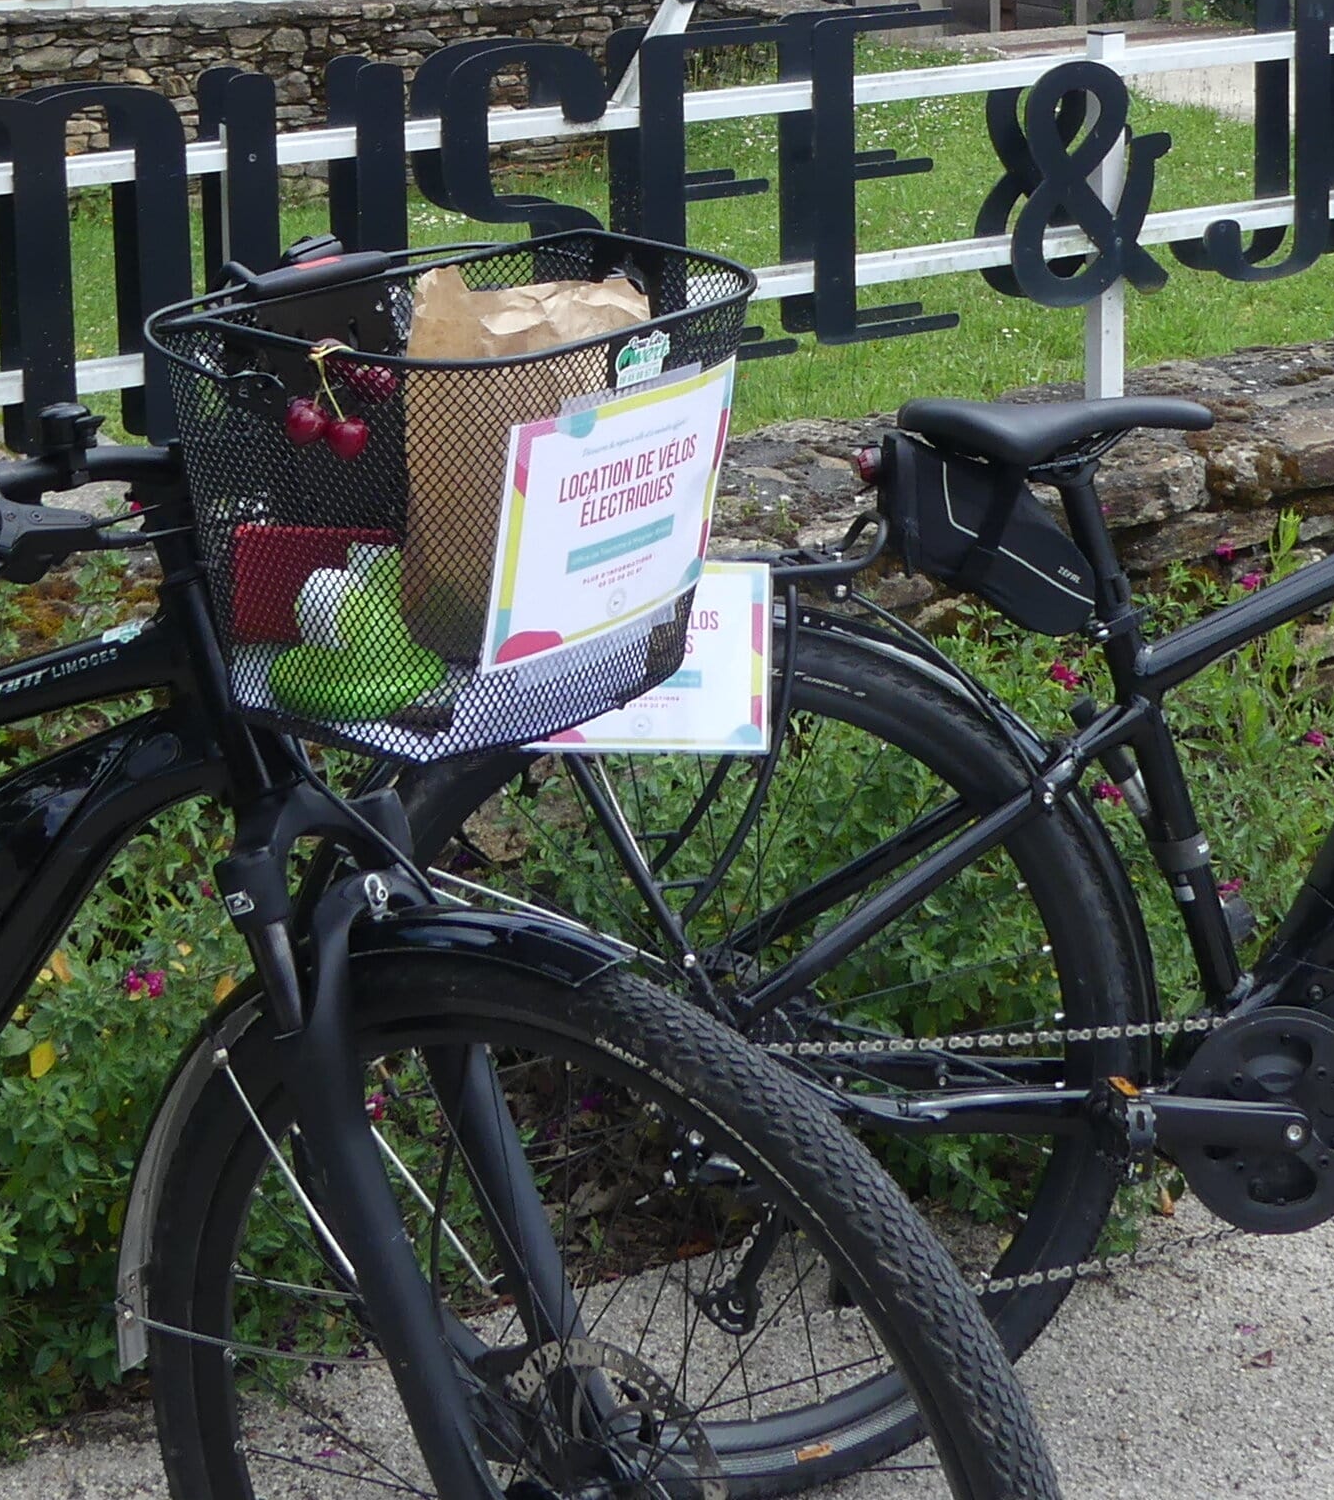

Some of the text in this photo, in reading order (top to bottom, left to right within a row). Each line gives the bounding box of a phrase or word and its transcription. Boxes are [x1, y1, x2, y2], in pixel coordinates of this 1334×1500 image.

[1013, 61, 1171, 307] &
[559, 457, 633, 503] LOCATION
[636, 450, 656, 480] DE
[659, 434, 698, 472] VÉLOS
[580, 473, 675, 527] ÉLECTRIQUES
[51, 648, 118, 678] LIMOGES
